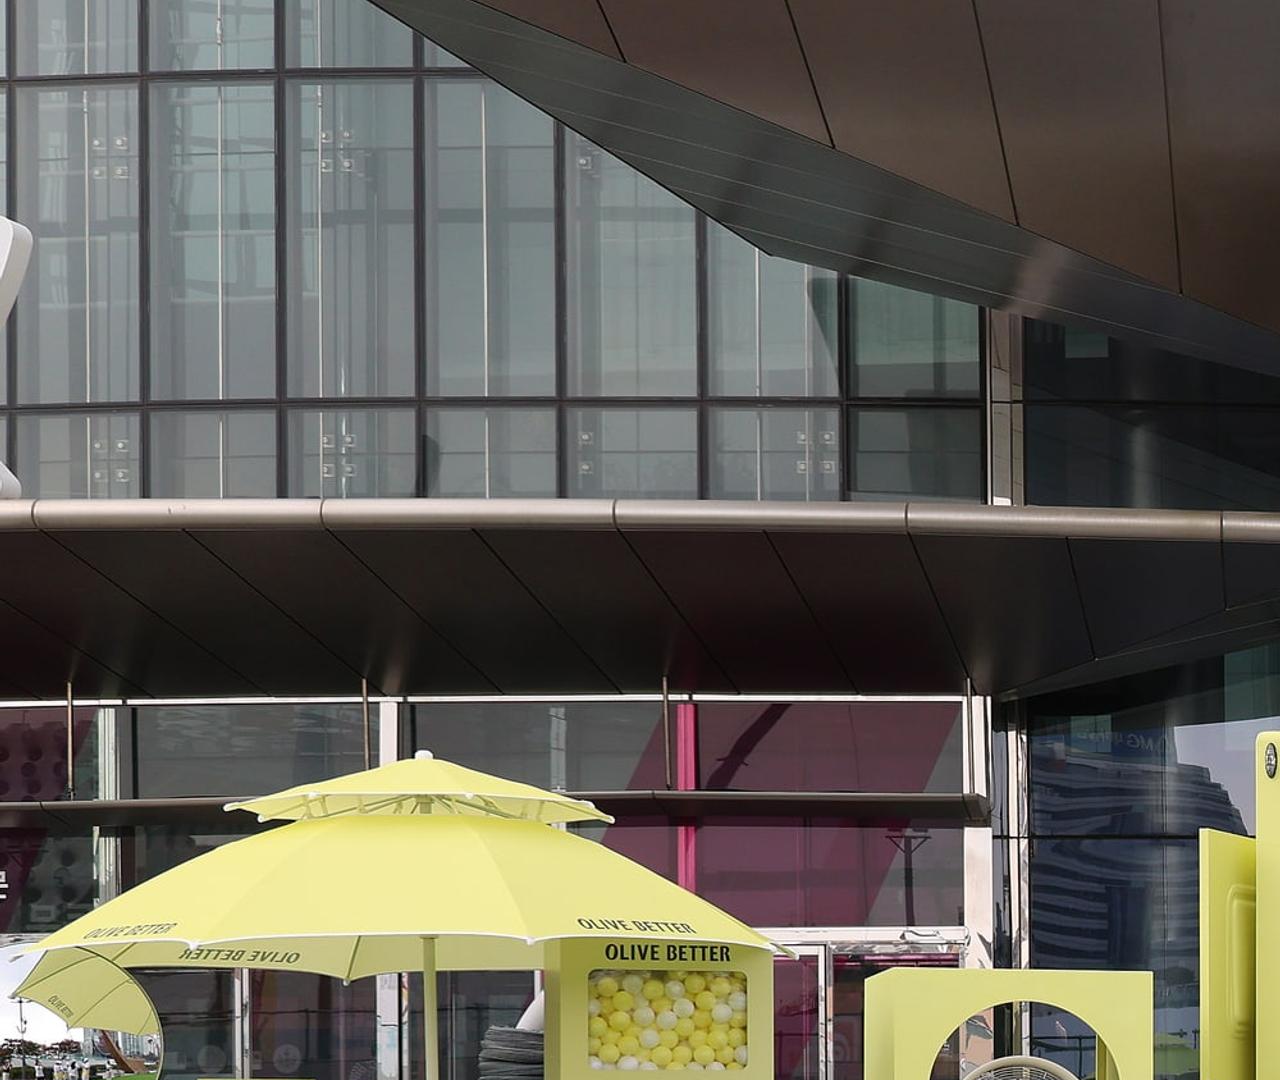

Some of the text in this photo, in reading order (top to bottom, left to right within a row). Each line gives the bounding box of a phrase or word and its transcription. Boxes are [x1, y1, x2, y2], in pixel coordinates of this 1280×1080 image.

[83, 922, 177, 939] OLIVE BETTER
[577, 918, 697, 934] OLIVE BETTER
[605, 943, 731, 962] OLIVE BETTER
